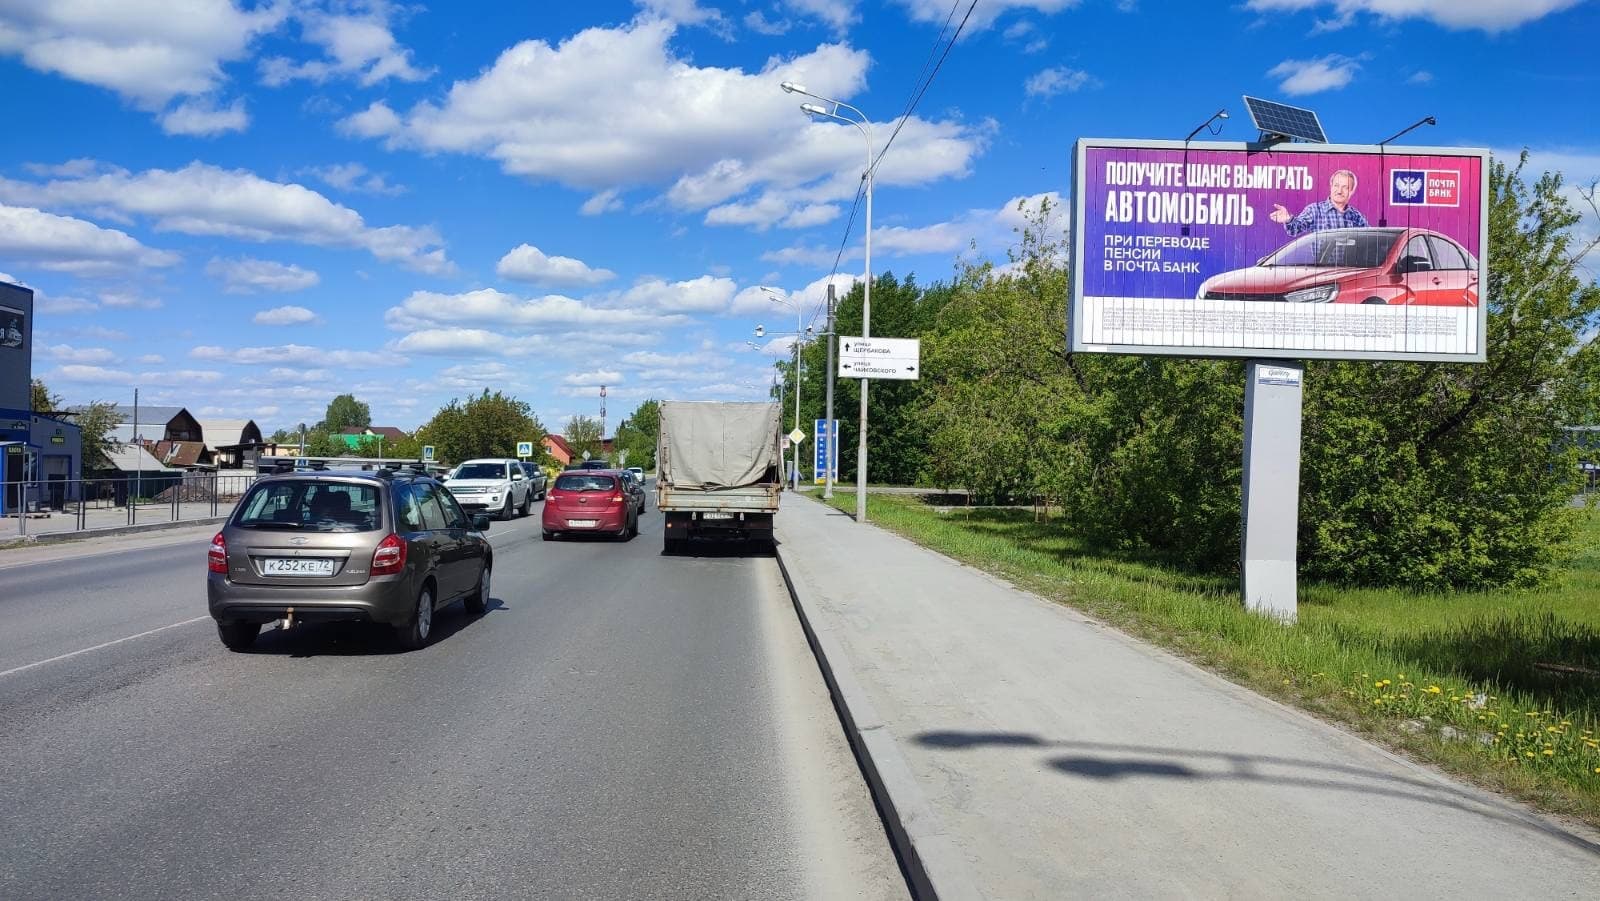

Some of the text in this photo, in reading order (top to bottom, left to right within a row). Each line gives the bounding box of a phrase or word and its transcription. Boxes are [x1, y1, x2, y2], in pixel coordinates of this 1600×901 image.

[1105, 161, 1313, 191] ПОЛУЧИТЕ ШАНС ВЫИГРАТЬ
[1429, 179, 1456, 188] ПОЧТА
[1429, 189, 1452, 198] БАНК
[1105, 190, 1254, 226] АВТОМОБИЛЬ
[1104, 235, 1210, 249] ПРИ ПЕРЕВОДЕ
[1104, 248, 1161, 260] ПЕНСИИ
[1104, 260, 1201, 274] В ПОЧТА БАНК
